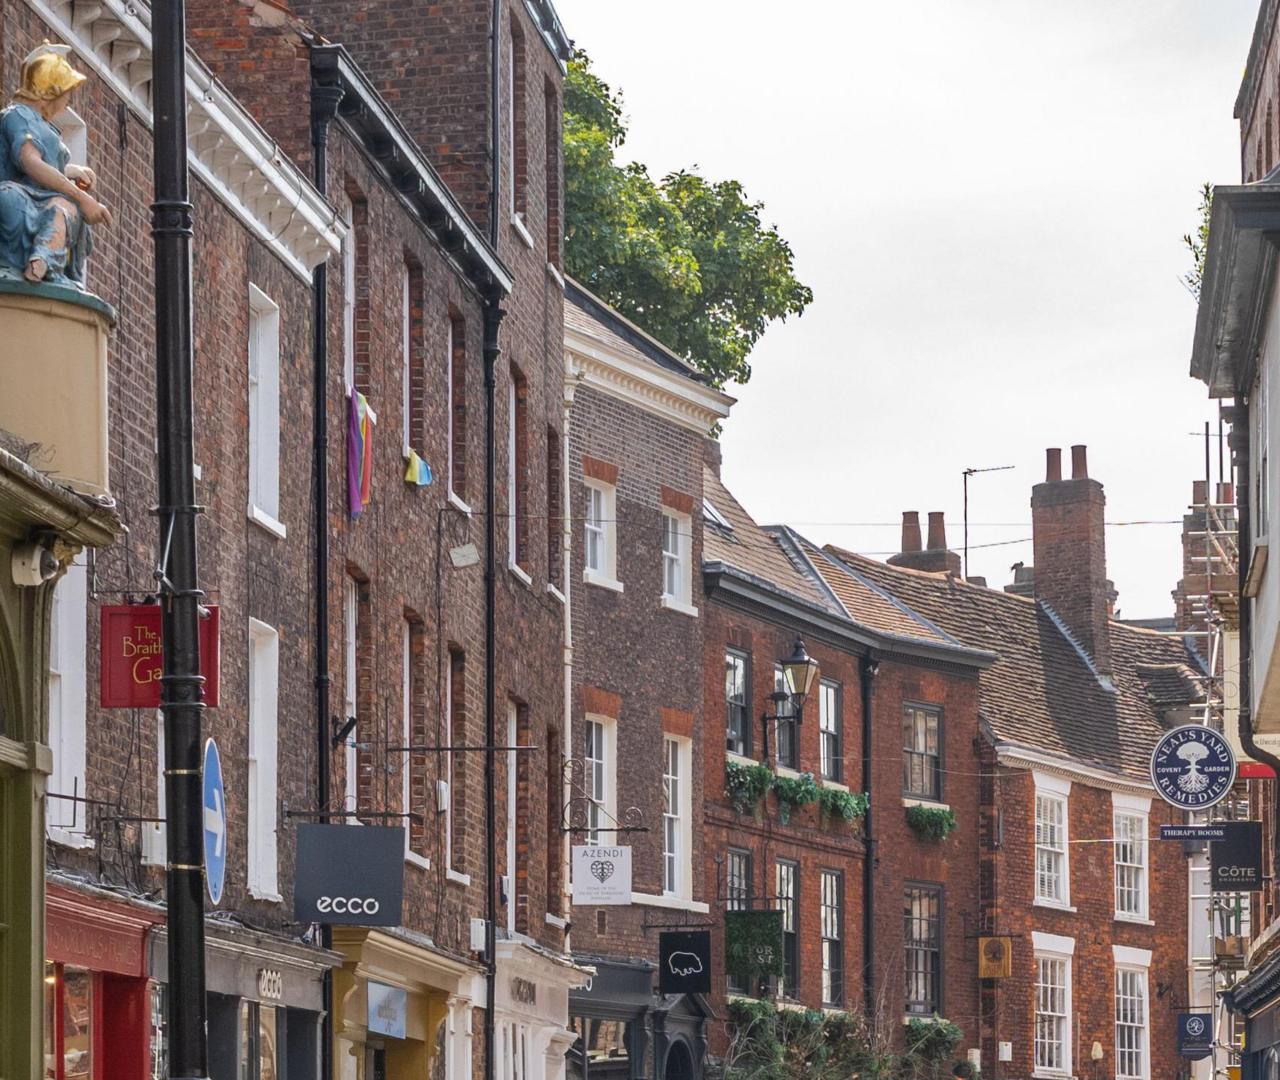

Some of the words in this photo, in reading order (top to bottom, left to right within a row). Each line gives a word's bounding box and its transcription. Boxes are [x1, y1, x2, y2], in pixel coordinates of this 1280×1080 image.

[134, 626, 157, 640] The
[123, 636, 163, 657] Braith
[133, 656, 162, 684] Ga
[1157, 730, 1197, 763] NEAL'S
[1201, 732, 1230, 763] YARD
[1160, 775, 1227, 804] REMEDIES
[582, 849, 623, 858] AZENDI
[317, 896, 380, 915] ecco
